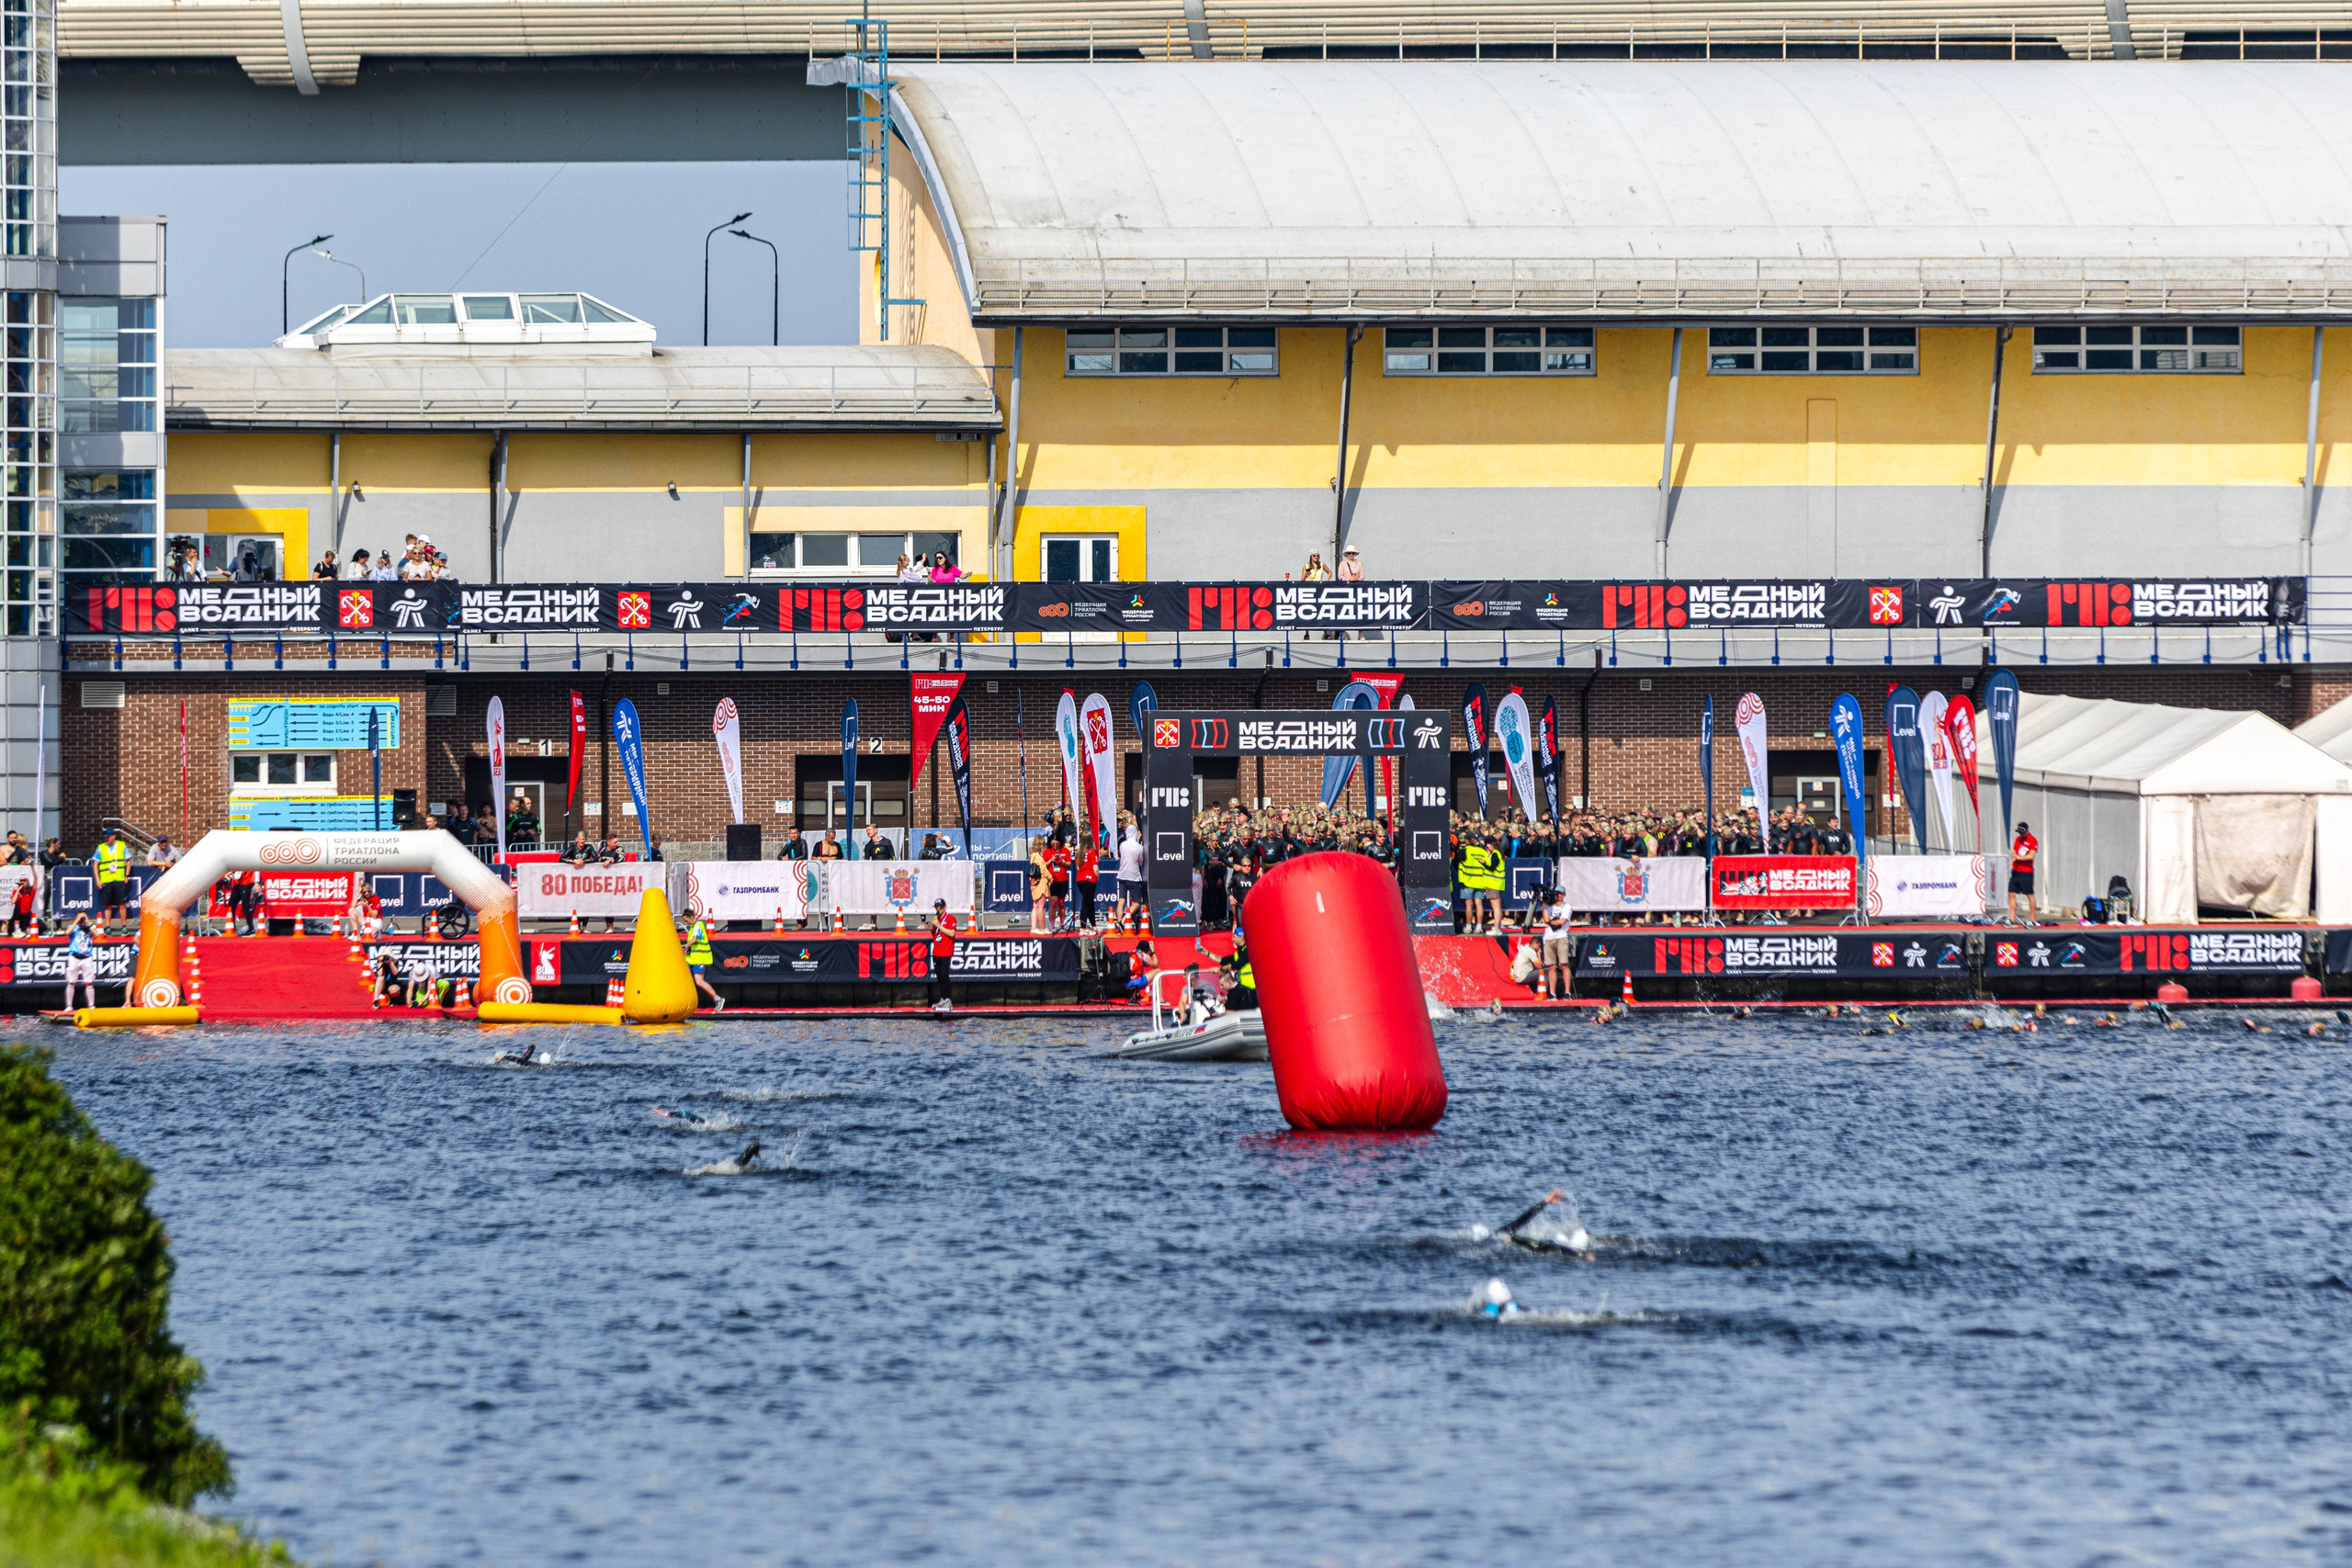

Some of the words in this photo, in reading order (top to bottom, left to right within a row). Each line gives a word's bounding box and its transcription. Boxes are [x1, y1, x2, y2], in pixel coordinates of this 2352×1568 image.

[179, 584, 321, 604] МЕДНЫЙ
[462, 587, 599, 606] МЕДНЫЙ
[867, 586, 1004, 605] МЕДНЫЙ
[1276, 585, 1412, 604] МЕДНЫЙ
[1690, 582, 1826, 602] МЕДНЫЙ
[2133, 581, 2268, 600] МЕДНЫЙ
[179, 604, 321, 622] ВСАДНИК
[462, 606, 599, 623] ВСАДНИК
[867, 605, 1004, 623] ВСАДНИК
[1276, 604, 1412, 620] ВСАДНИК
[1690, 603, 1826, 618] ВСАДНИК
[2133, 601, 2268, 617] ВСАДНИК
[914, 695, 950, 704] 45-50
[919, 705, 944, 713] МИН
[1238, 718, 1356, 735] МЕДНЫЙ
[540, 739, 548, 755] 1
[871, 738, 882, 753] 2
[1239, 736, 1356, 750] ВСАДНИК
[334, 847, 400, 855] ТРИАТЛОНА
[1157, 848, 1184, 861] Level
[1413, 847, 1442, 860] Level
[334, 857, 378, 865] РОССИИ
[1769, 868, 1850, 880] МЕДНЫЙ
[266, 876, 348, 889] МЕДНЫЙ
[541, 874, 567, 897] 80
[571, 875, 643, 896] ПОБЕДА!
[1770, 880, 1850, 891] ВСАДНИК
[1911, 882, 1958, 890] ГАЗПРОМБАНК
[266, 889, 348, 899] ВСАДНИК
[380, 893, 404, 907] evel
[993, 889, 1023, 902] Level
[1094, 890, 1120, 902] evel
[62, 896, 93, 908] Level
[1725, 935, 1838, 953] МЕДНЫЙ
[2190, 931, 2302, 949] МЕДНЫЙ
[931, 940, 1042, 955] ЕДНЫЙ
[931, 956, 1042, 969] САДНИК
[1725, 953, 1838, 966] ВСАДНИК
[2190, 949, 2301, 963] ВСАДНИК
[16, 962, 130, 976] ВСАИК
